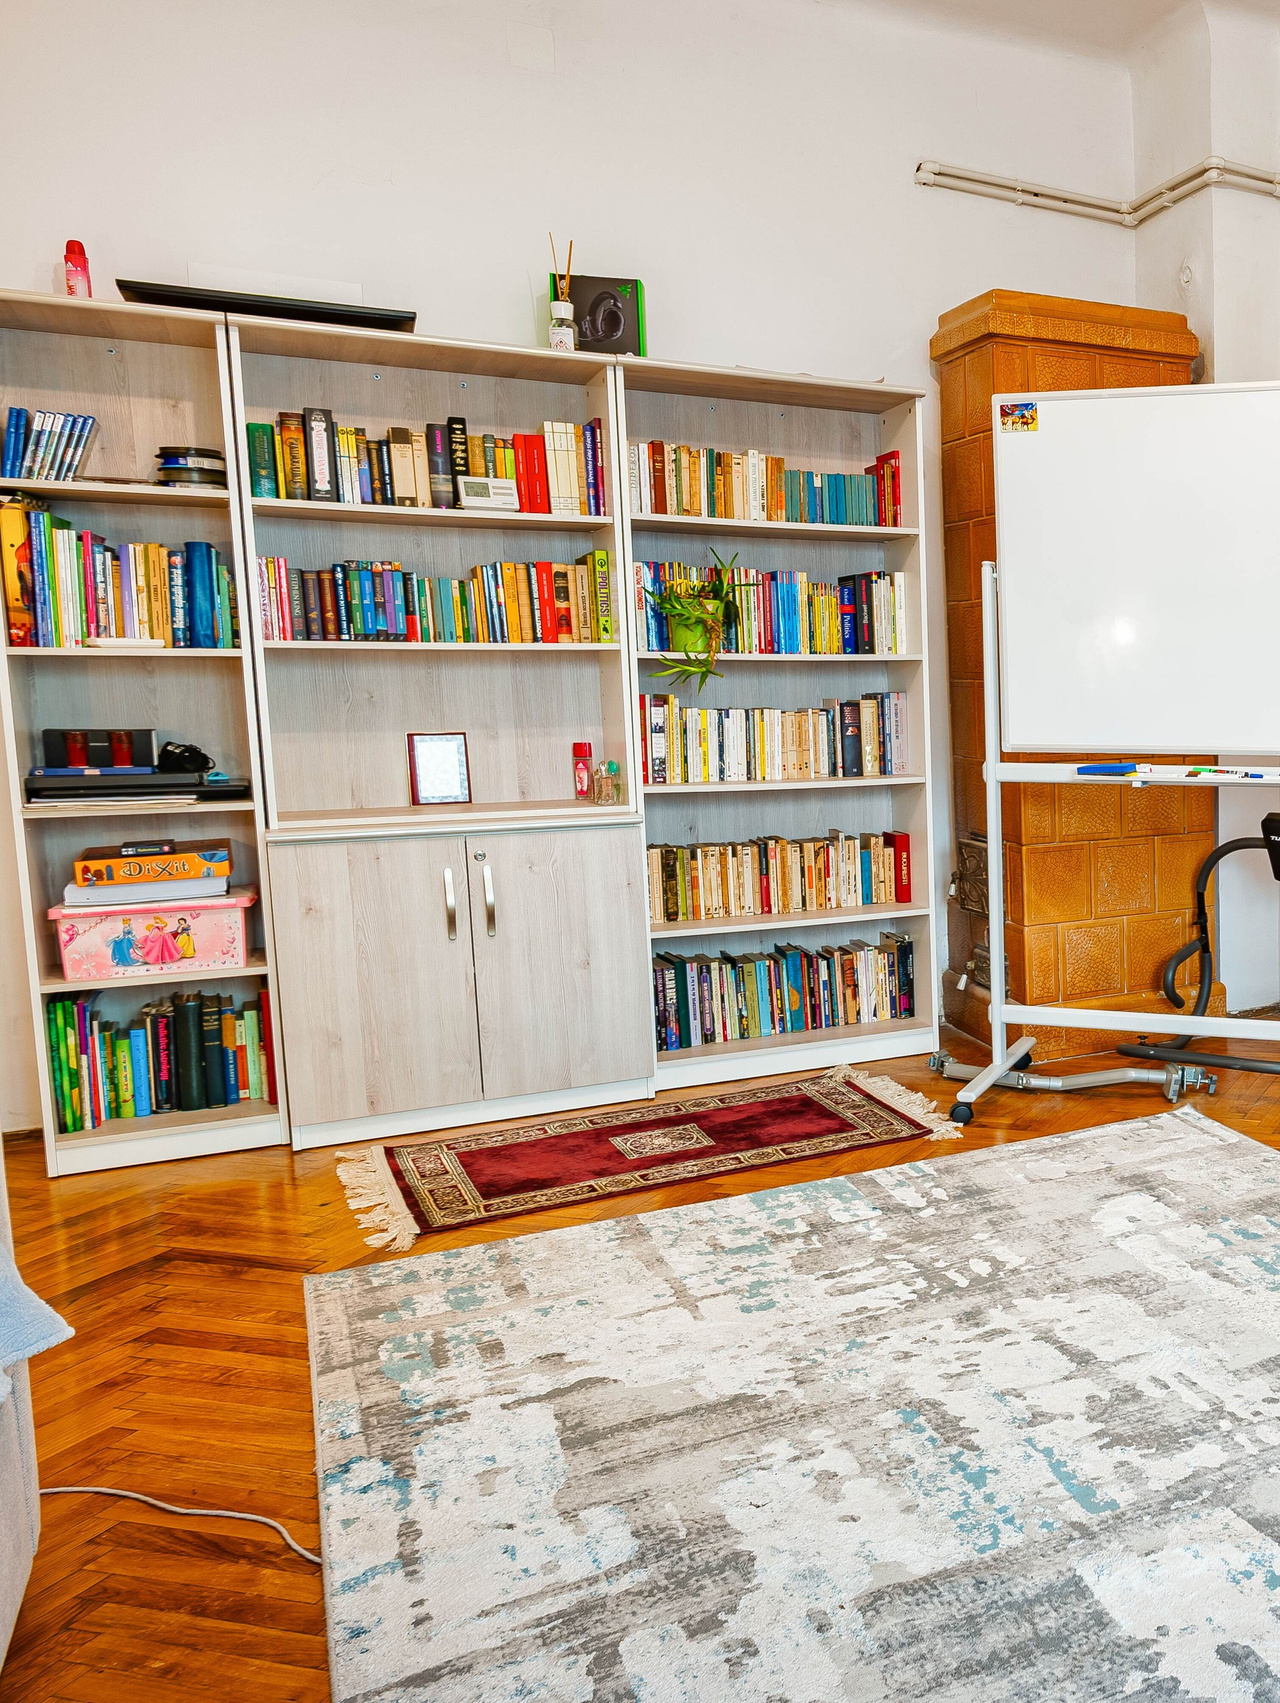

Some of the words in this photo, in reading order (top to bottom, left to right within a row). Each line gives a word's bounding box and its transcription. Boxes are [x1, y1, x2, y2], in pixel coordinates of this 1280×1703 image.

[315, 424, 325, 450] EMPIRE
[317, 459, 327, 488] VAMPIRE
[291, 574, 300, 600] STEPHEN
[598, 576, 610, 614] POLITICS
[293, 600, 302, 616] KING
[844, 615, 852, 638] Politics
[665, 969, 676, 988] SOLAR
[158, 1017, 169, 1050] Predictive
[160, 1049, 171, 1081] Astrology
